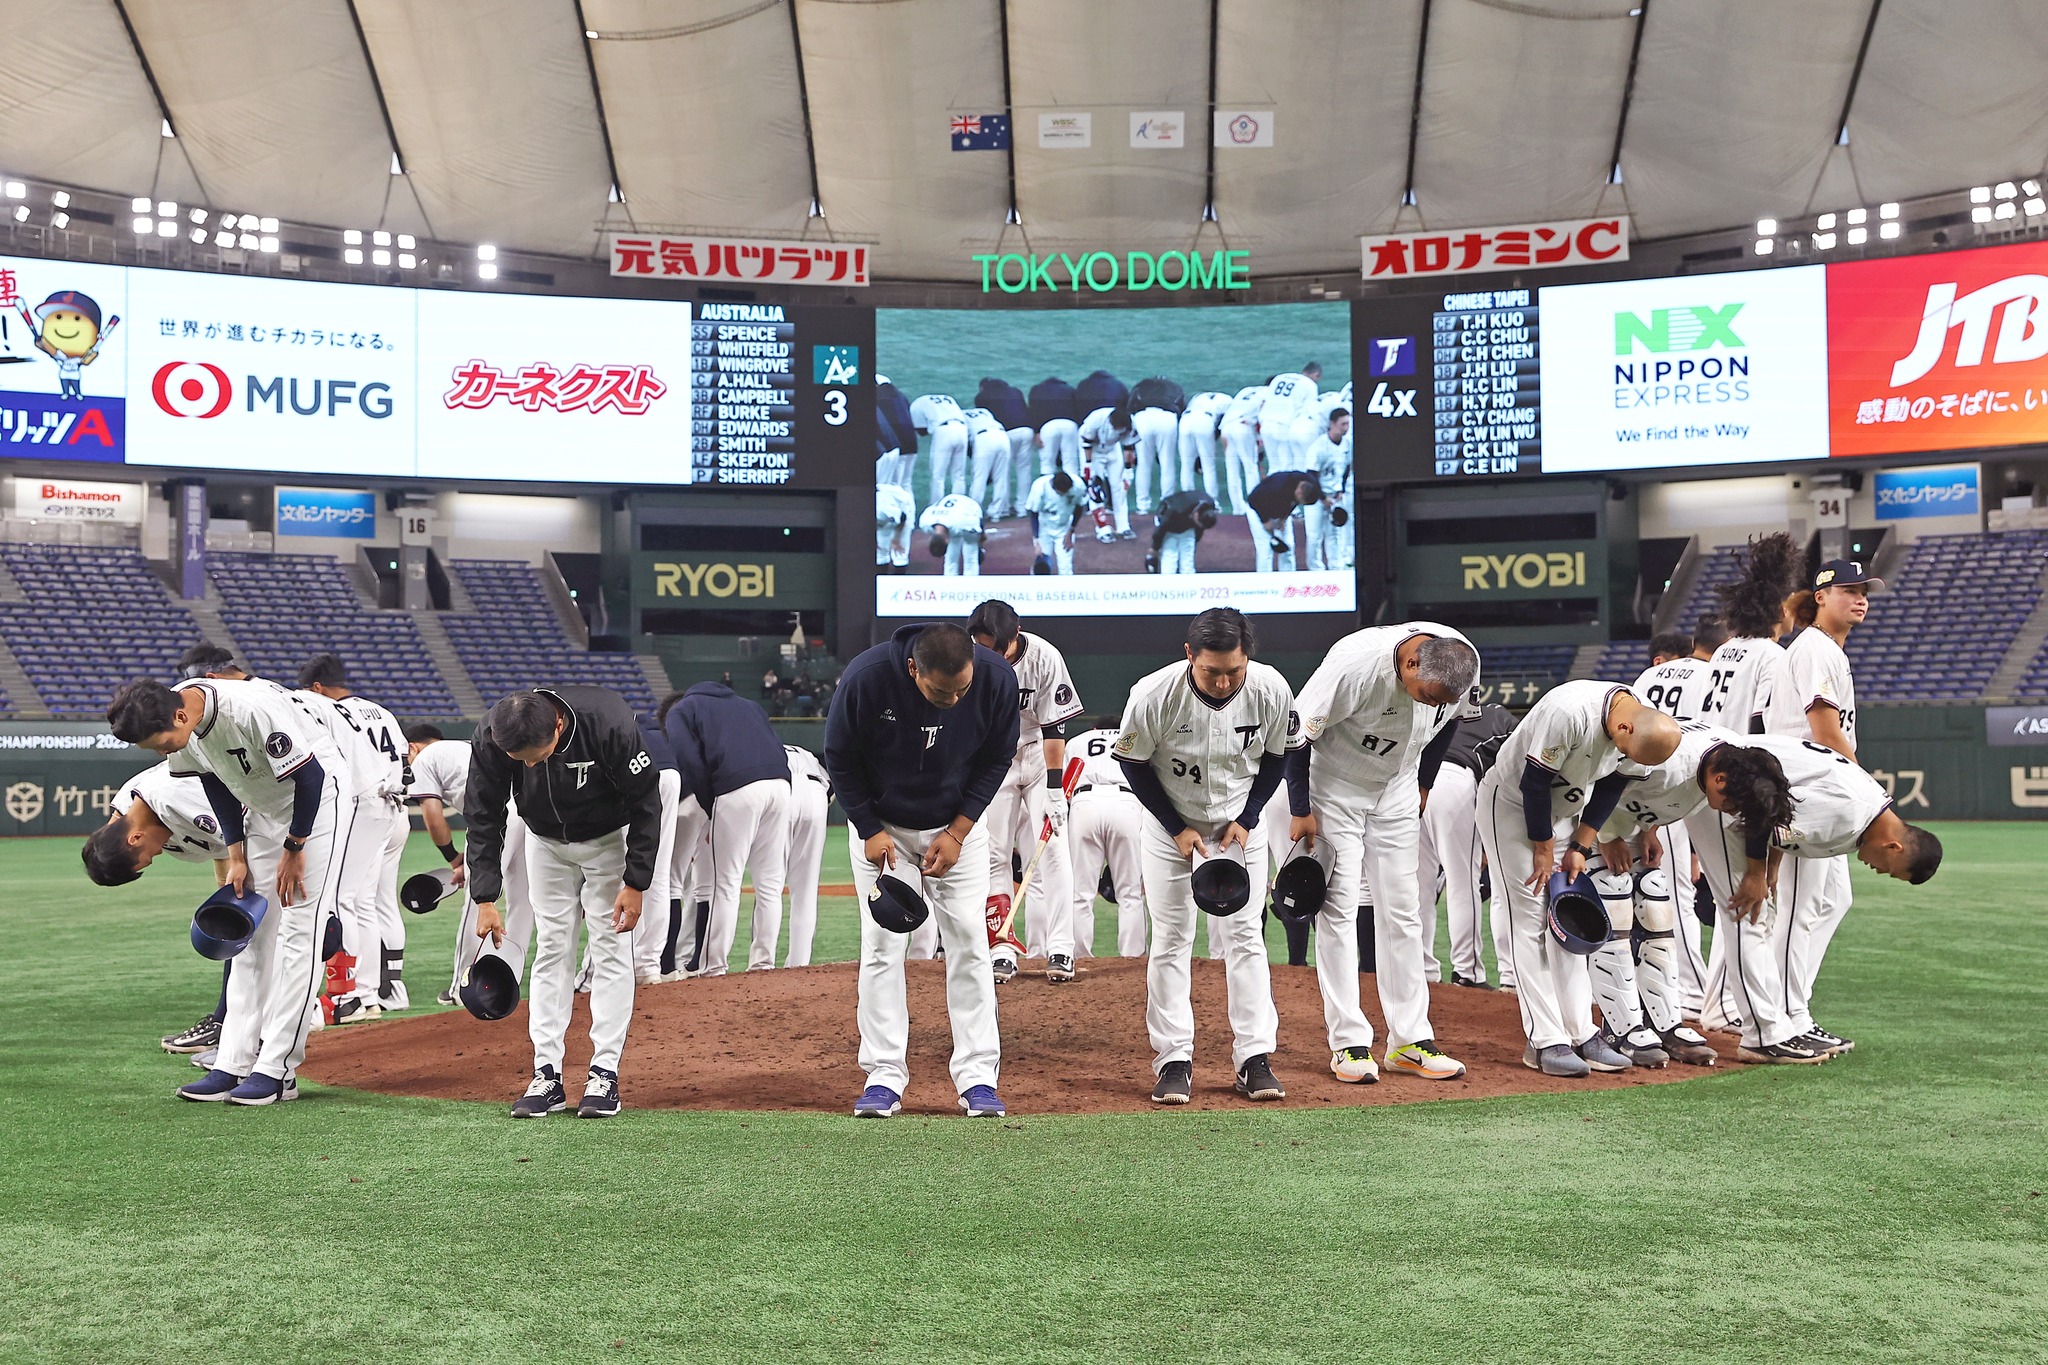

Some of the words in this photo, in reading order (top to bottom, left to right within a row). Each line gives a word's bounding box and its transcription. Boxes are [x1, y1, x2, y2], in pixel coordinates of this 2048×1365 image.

[1370, 221, 1620, 276] オロナミンC
[972, 251, 1119, 293] TOKYO
[1127, 250, 1251, 291] DOME
[1444, 292, 1493, 311] CHINESE
[1493, 290, 1530, 308] TAIPEI
[701, 304, 784, 321] AUSTRALIA
[1460, 314, 1487, 330] T.H
[1490, 311, 1525, 328] KUO
[159, 318, 394, 351] 世界が進むチカラになる。
[718, 326, 777, 341] SPENCE
[1461, 330, 1487, 346] C.C
[1490, 327, 1529, 344] CHIU
[1889, 274, 2048, 388] JTB
[717, 342, 789, 357] WHITEFIELD
[1461, 346, 1488, 362] C.H
[1491, 343, 1534, 360] CHEN
[717, 358, 789, 373] WINGROVE
[1461, 362, 1487, 378] J.H
[1490, 360, 1516, 376] LIU
[1615, 356, 1748, 384] NIPPON
[444, 359, 667, 415] カーネクスト
[717, 374, 772, 389] A.HALL
[1462, 378, 1489, 394] H.C
[1492, 376, 1518, 392] LIN
[247, 375, 393, 419] MUFG
[717, 389, 789, 404] CAMPBELL
[1368, 382, 1418, 418] 4x
[1462, 394, 1489, 410] H.Y
[1492, 393, 1515, 408] HO
[1615, 381, 1749, 409] EXPRESS
[718, 405, 771, 420] BURKE
[823, 389, 848, 426] 3
[1462, 410, 1486, 426] C.Y
[1487, 408, 1535, 425] CHANG
[718, 421, 789, 436] EDWARDS
[1462, 426, 1489, 442] C.W
[1490, 425, 1511, 440] LIN
[1512, 424, 1535, 439] WU
[1616, 429, 1640, 442] We
[1646, 426, 1678, 440] Find
[1684, 425, 1709, 438] the
[1715, 424, 1750, 439] Way
[718, 437, 766, 451] SMITH
[1462, 442, 1490, 458] C.K
[1493, 441, 1519, 457] LIN
[718, 452, 788, 468] SKEPTON
[1463, 459, 1489, 475] C.E
[1491, 457, 1517, 473] LIN
[718, 468, 789, 484] SHERRIFF
[42, 485, 121, 502] Bishamon
[1820, 501, 1840, 516] 34
[409, 518, 426, 534] 16
[654, 563, 774, 597] RYOBI
[1461, 552, 1585, 590] RYOBI
[904, 590, 937, 601] ASIA
[940, 591, 1032, 601] PROFESSIONAL
[1036, 590, 1099, 601] BASEBALL
[1103, 590, 1197, 601] CHAMPIONSHIP
[1200, 588, 1230, 599] 2023
[1656, 668, 1694, 679] HSIAO
[1702, 670, 1735, 713] 25
[367, 726, 399, 761] 14
[1361, 734, 1398, 757] 87
[629, 751, 651, 775] 86
[1171, 758, 1202, 784] 34
